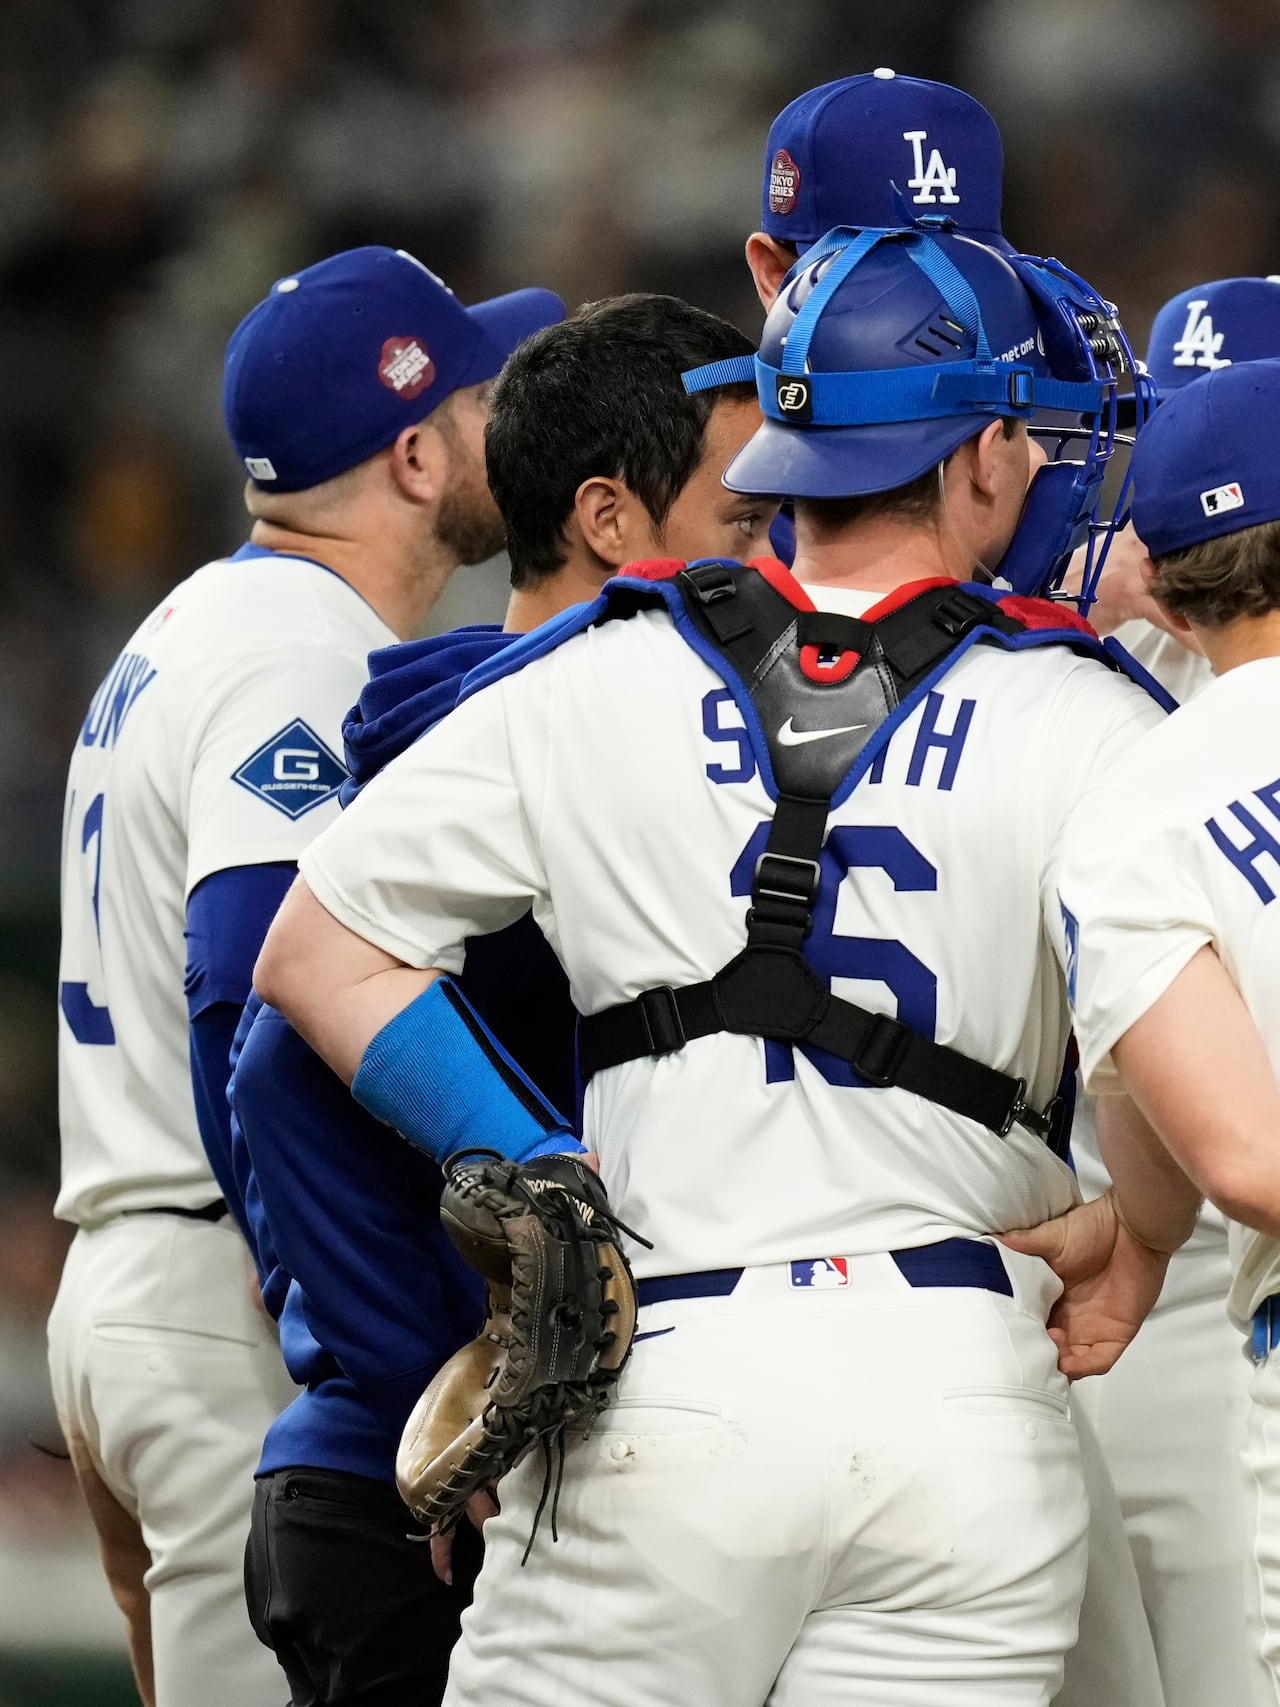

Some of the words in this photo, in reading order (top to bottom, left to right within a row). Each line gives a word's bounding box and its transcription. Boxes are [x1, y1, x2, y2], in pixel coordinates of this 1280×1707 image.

[903, 130, 960, 205] LA
[1020, 336, 1035, 356] one
[1173, 300, 1225, 370] LA
[273, 748, 320, 781] G
